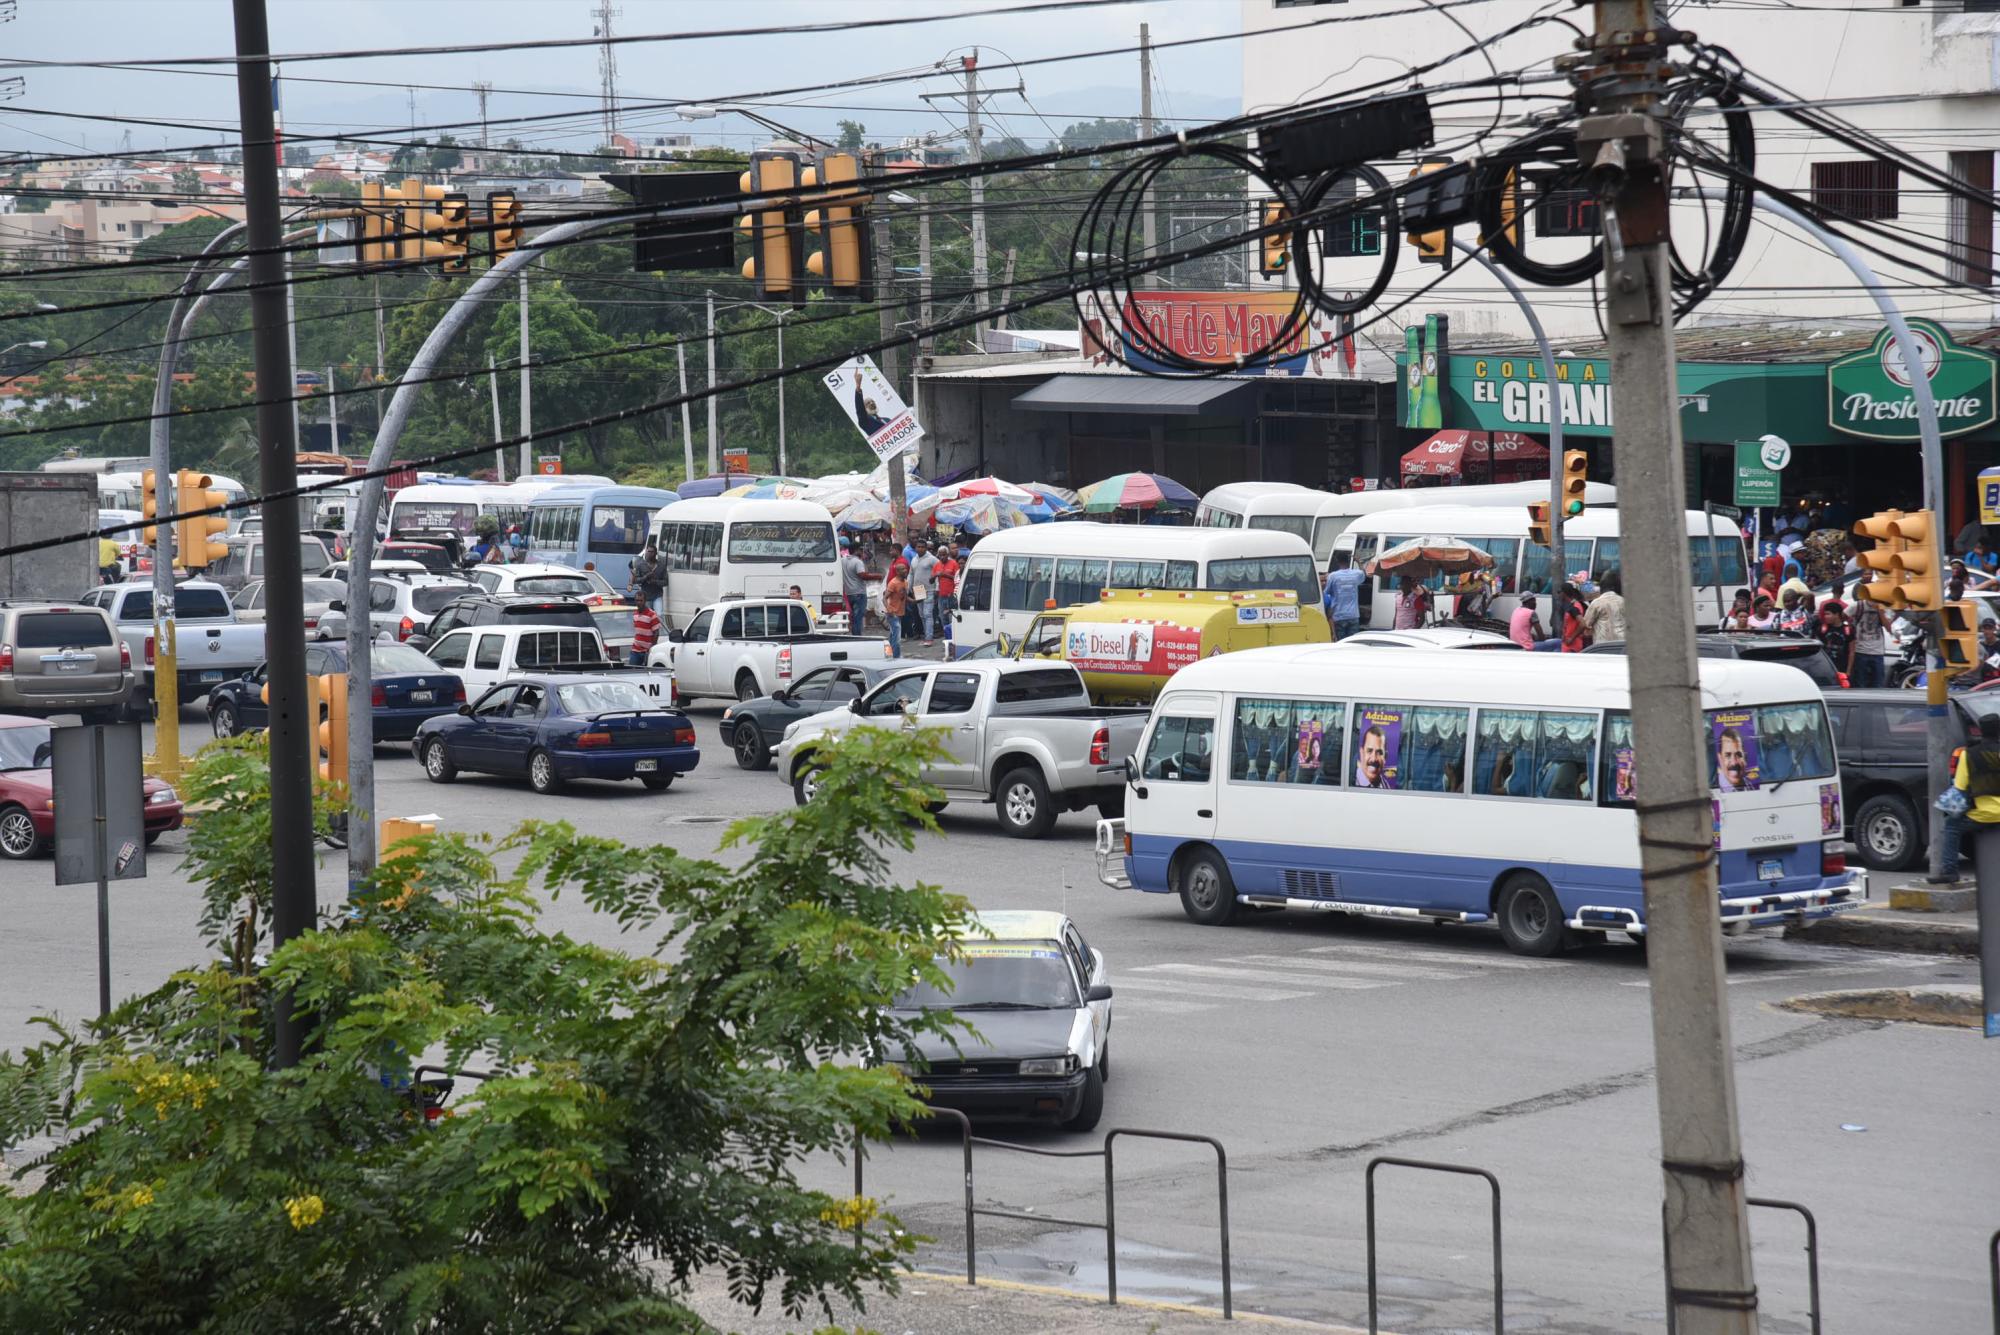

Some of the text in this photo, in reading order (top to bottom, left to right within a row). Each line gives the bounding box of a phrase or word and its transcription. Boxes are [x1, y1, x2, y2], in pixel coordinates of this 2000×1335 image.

[1130, 301, 1303, 367] Sol de Mayo
[1474, 380, 1498, 402] EL
[1842, 392, 1981, 421] Presidnte
[876, 422, 917, 455] SENADOR
[1428, 439, 1459, 453] Claro
[1262, 608, 1298, 619] Diesel
[1090, 634, 1125, 655] Diesel
[1365, 711, 1399, 722] Adriano
[1716, 712, 1750, 723] Adriano
[1752, 833, 1794, 843] COASTER
[1822, 902, 1858, 913] COASTER
